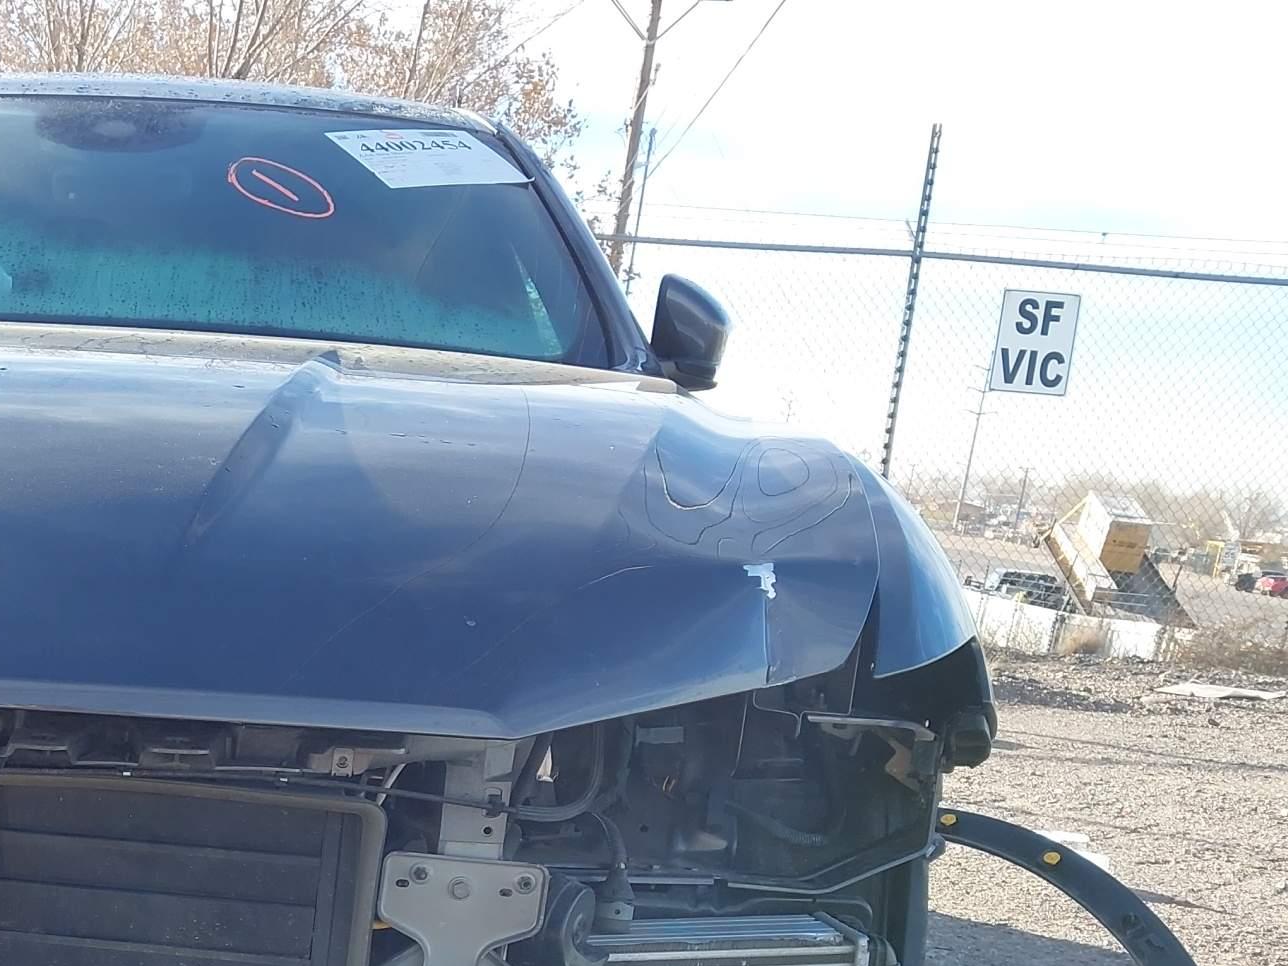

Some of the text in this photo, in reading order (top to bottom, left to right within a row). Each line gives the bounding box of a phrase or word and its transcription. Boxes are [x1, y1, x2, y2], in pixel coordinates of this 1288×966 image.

[360, 140, 472, 153] 44002454
[1015, 297, 1065, 336] SF
[1000, 347, 1066, 388] VIC
